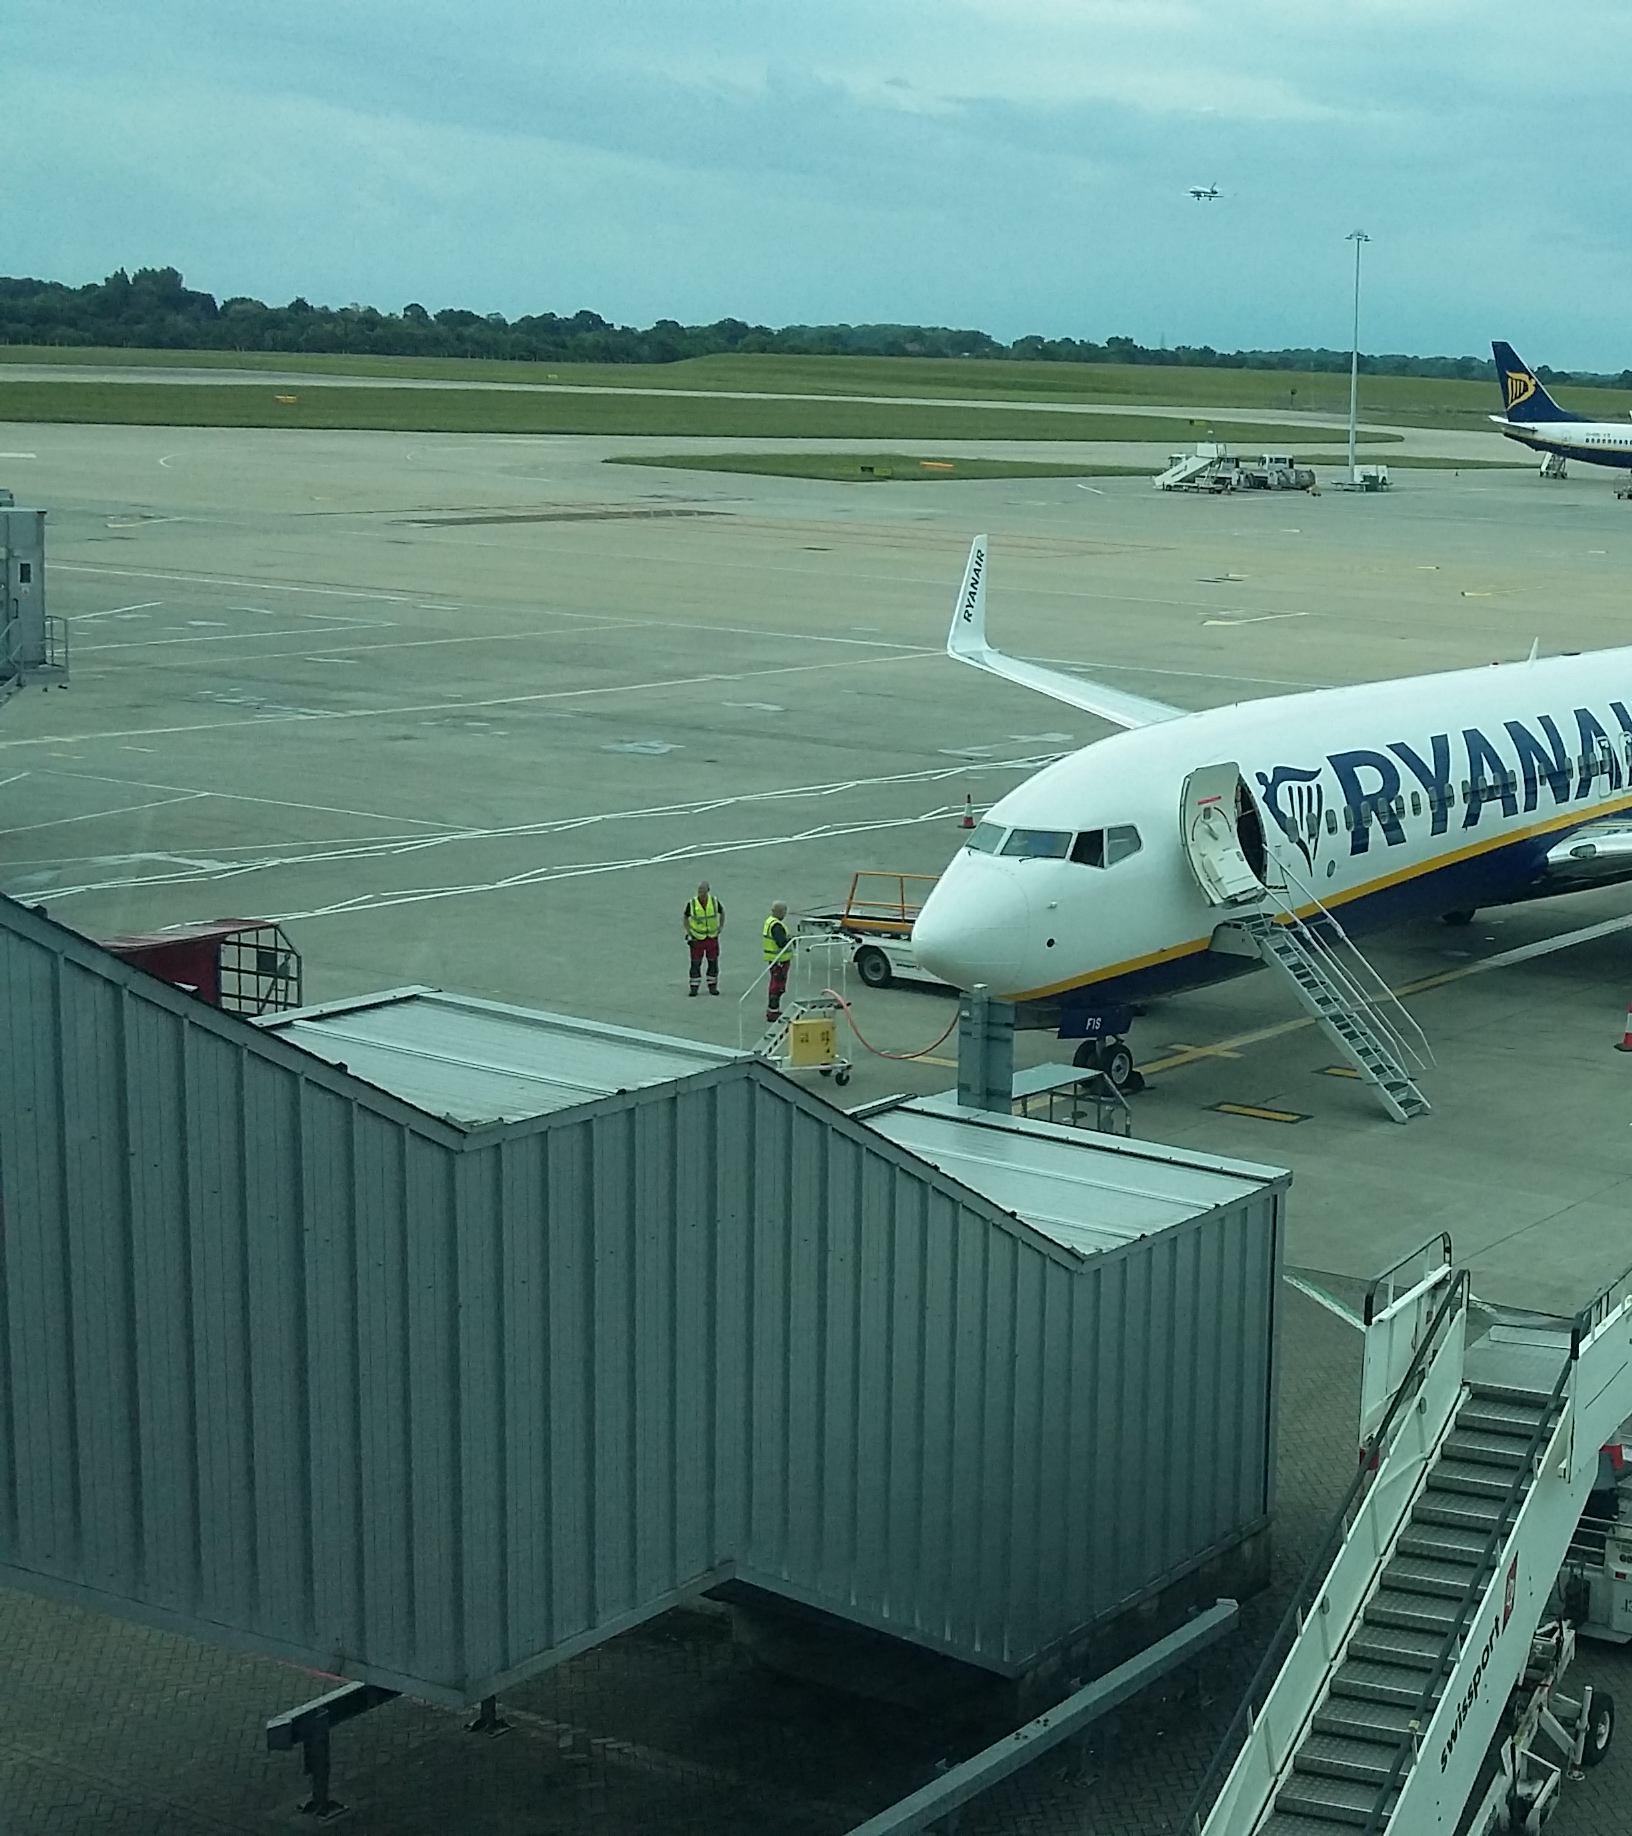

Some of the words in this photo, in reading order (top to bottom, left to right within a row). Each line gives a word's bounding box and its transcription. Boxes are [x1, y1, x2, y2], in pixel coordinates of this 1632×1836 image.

[963, 549, 984, 623] RYANAIR
[1085, 1017, 1102, 1030] FIS
[1440, 1615, 1500, 1774] swissport
